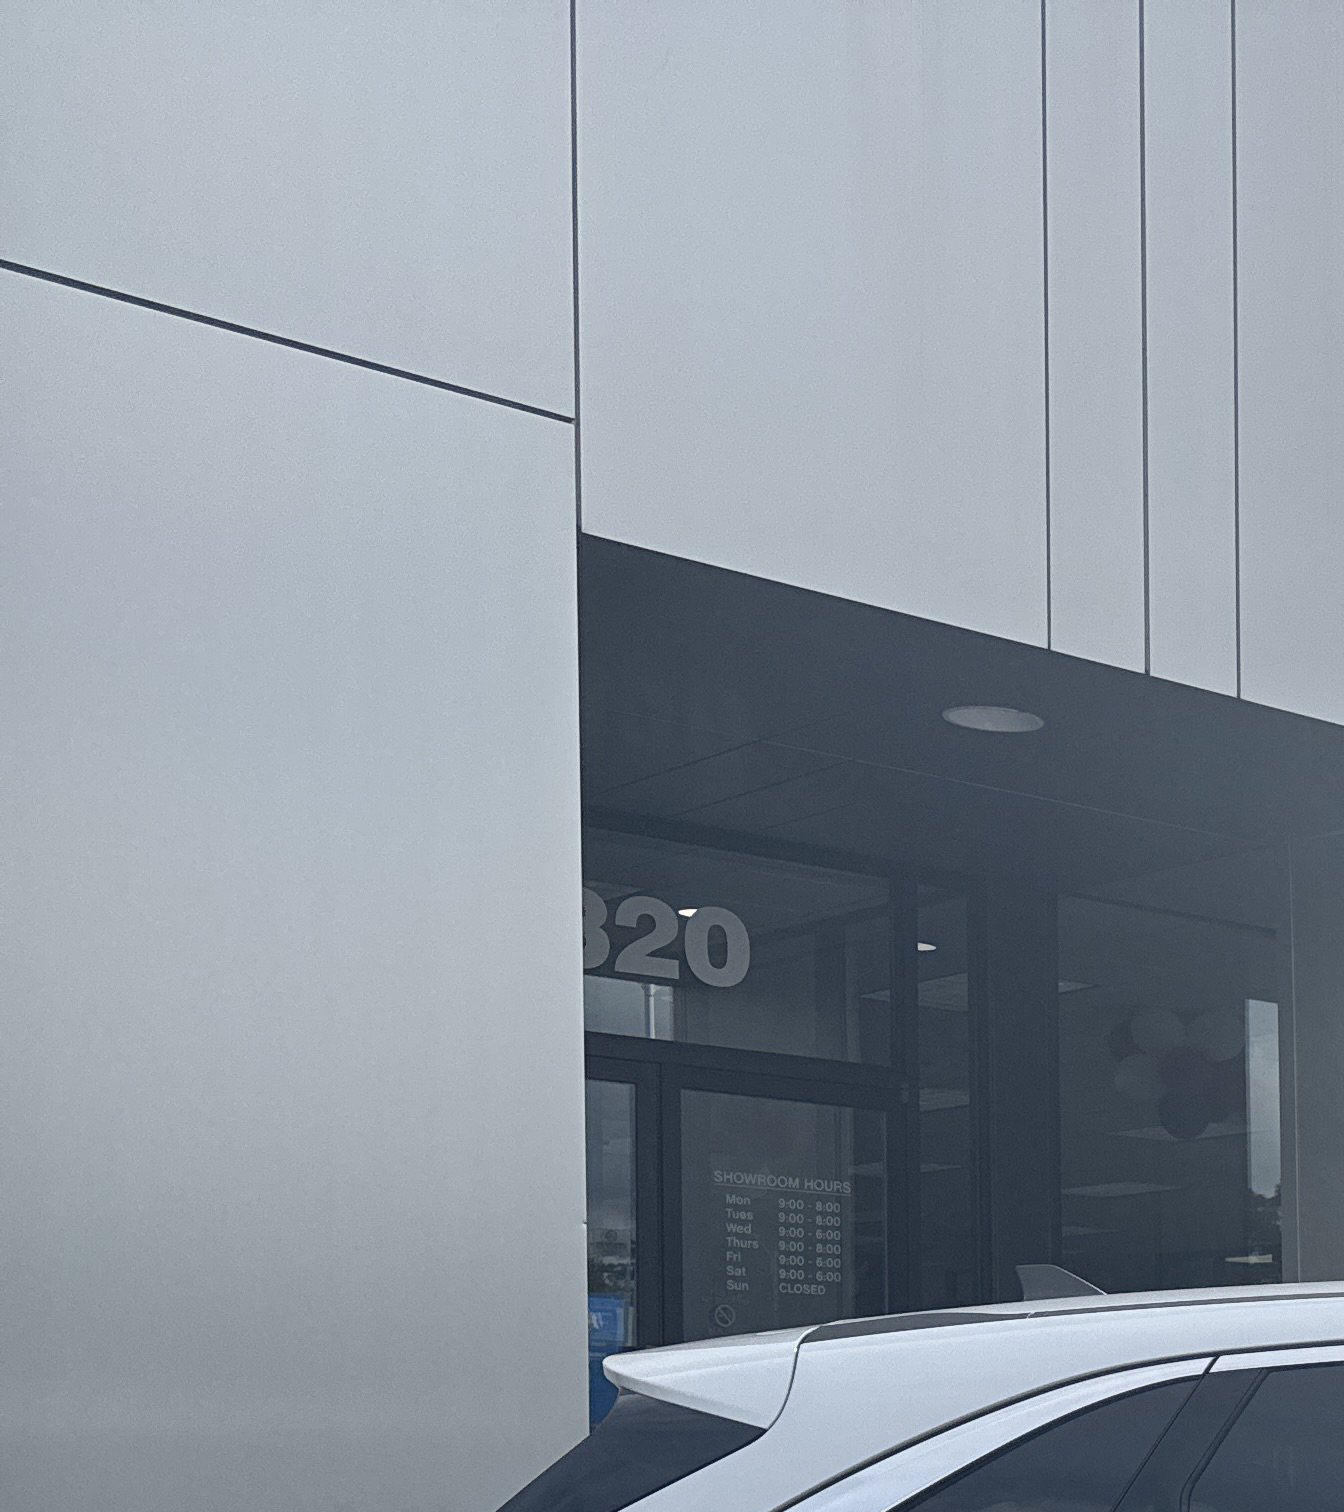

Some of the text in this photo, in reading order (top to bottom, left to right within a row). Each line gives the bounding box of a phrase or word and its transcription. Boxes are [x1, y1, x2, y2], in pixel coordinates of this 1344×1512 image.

[713, 1170, 852, 1193] SHOWROOM HOURS
[726, 1194, 750, 1205] Mon
[778, 1198, 804, 1210] 9:00
[815, 1201, 841, 1212] 8:00
[726, 1208, 754, 1220] Tues
[778, 1212, 804, 1224] 9:00
[815, 1215, 841, 1227] 8:00
[726, 1222, 752, 1235] Wed
[778, 1226, 804, 1238] 9:00
[815, 1229, 841, 1241] 6:00
[726, 1237, 760, 1249] Thurs
[778, 1240, 804, 1252] 9:00
[815, 1243, 841, 1255] 8:00
[726, 1251, 741, 1262] Fri
[778, 1255, 804, 1266] 9:00
[815, 1258, 841, 1269] 6:00
[726, 1265, 747, 1277] Sat
[778, 1269, 804, 1280] 9:00
[815, 1272, 841, 1283] 6:00
[726, 1279, 826, 1295] Sun CLOSED
